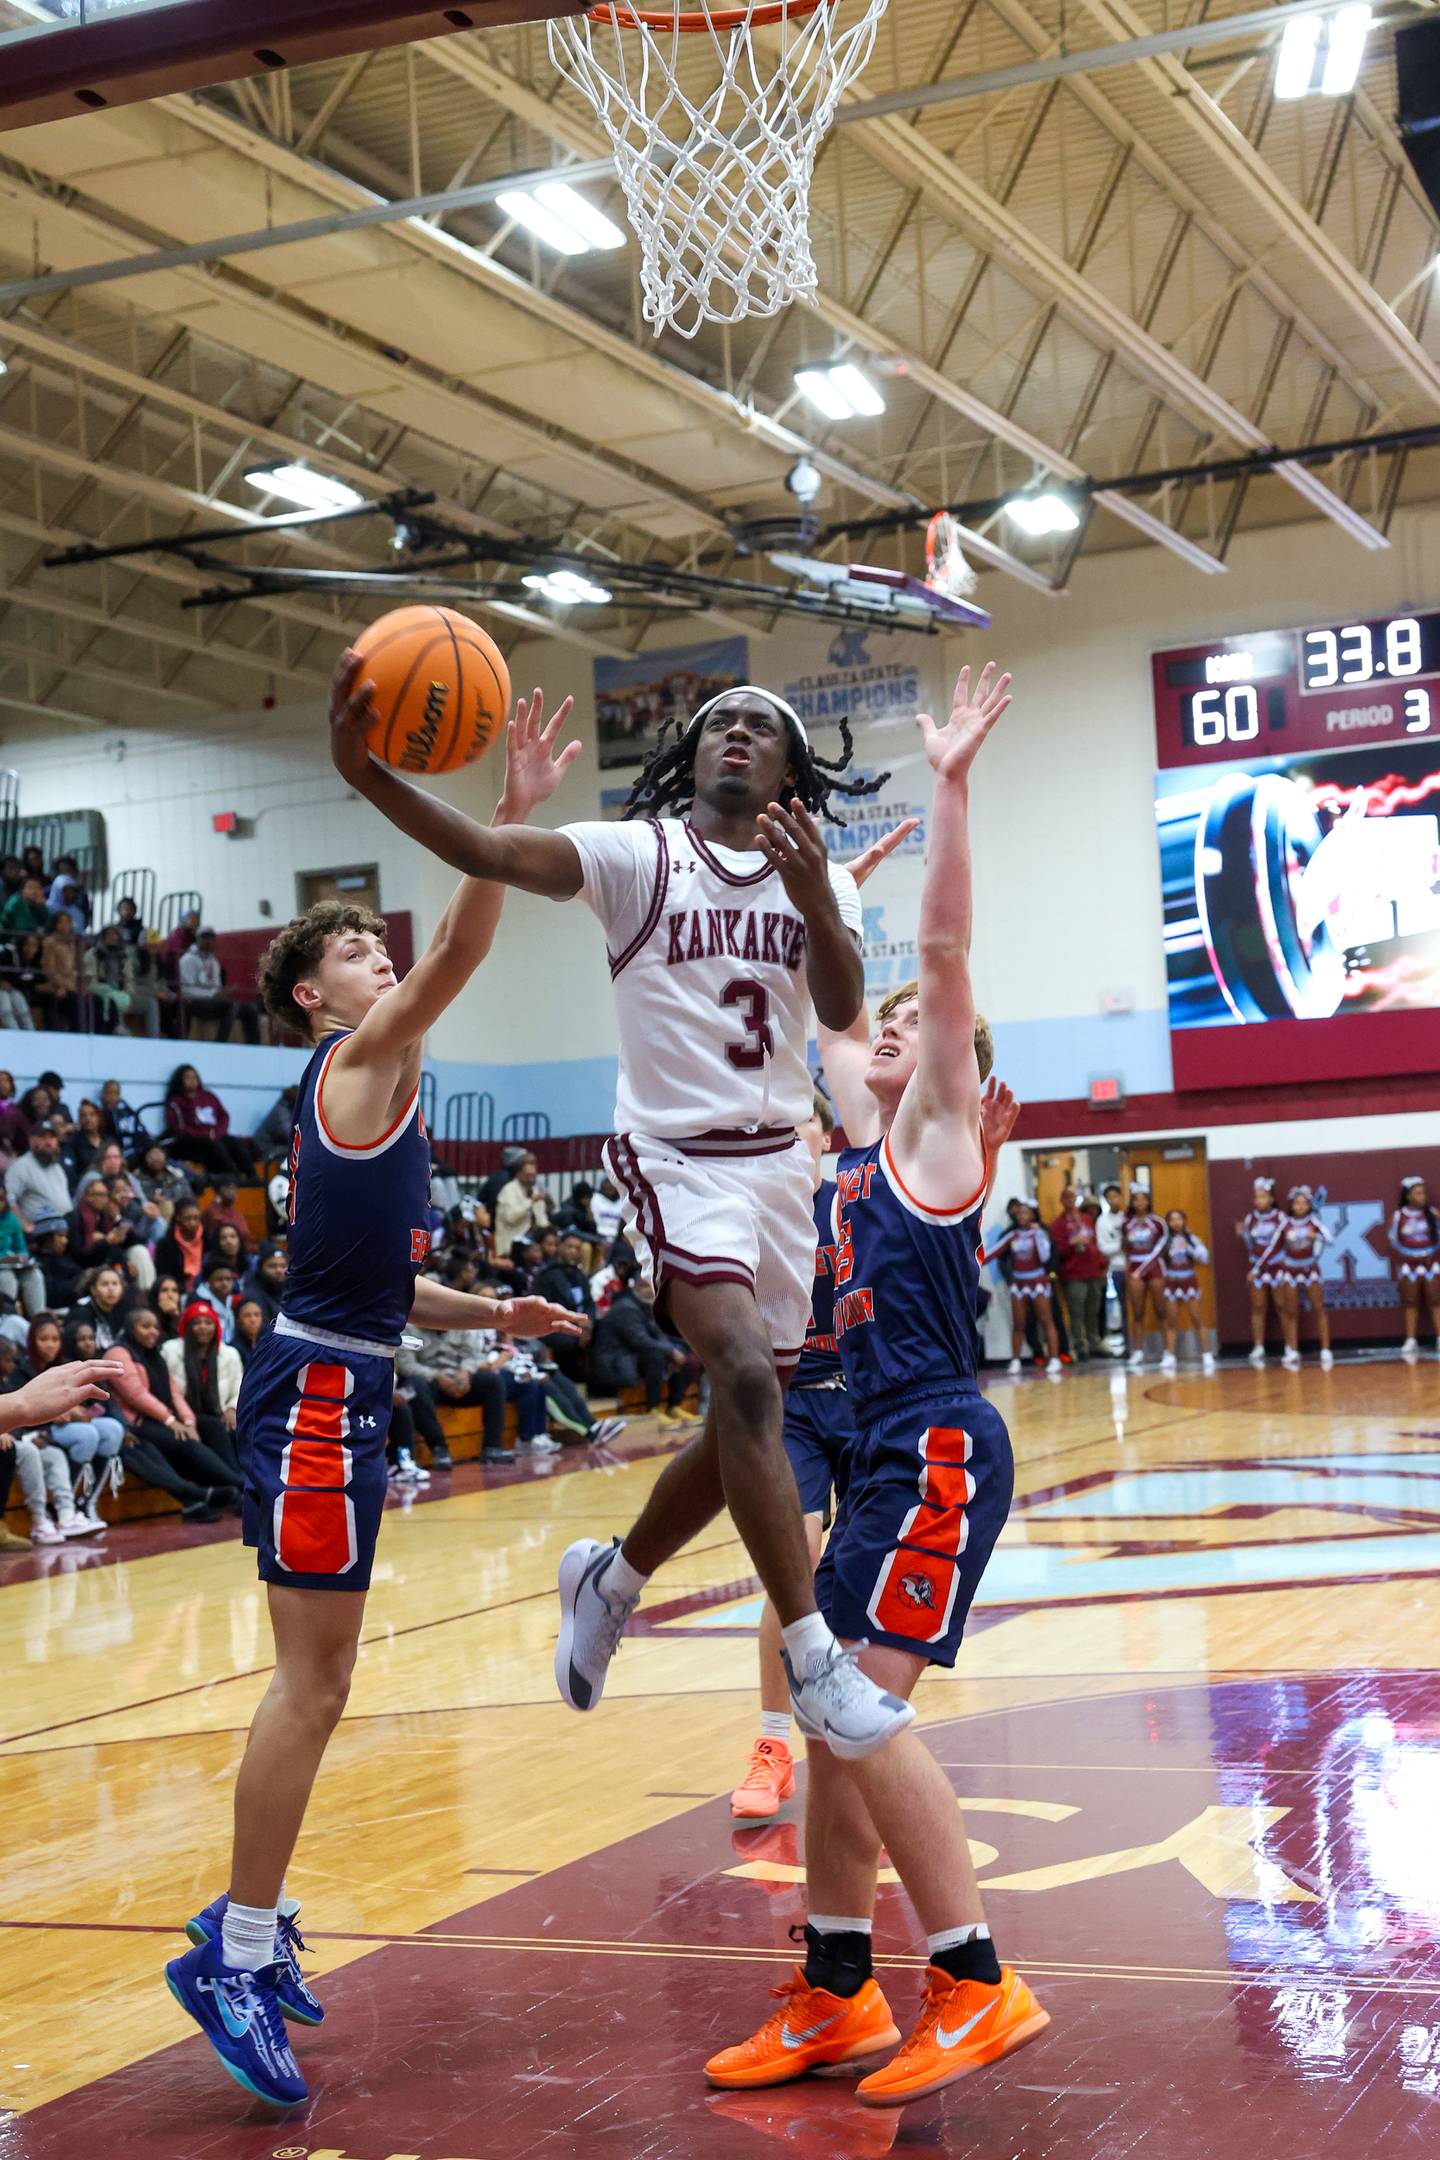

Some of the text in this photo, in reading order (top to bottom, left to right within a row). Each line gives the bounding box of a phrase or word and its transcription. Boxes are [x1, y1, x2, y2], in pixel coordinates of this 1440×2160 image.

[1305, 618, 1422, 688] 33.8
[1191, 685, 1259, 746] 60
[1326, 704, 1394, 732] PERIOD
[1403, 688, 1431, 733] 3
[719, 976, 775, 1072] 3
[1316, 1199, 1392, 1281] K
